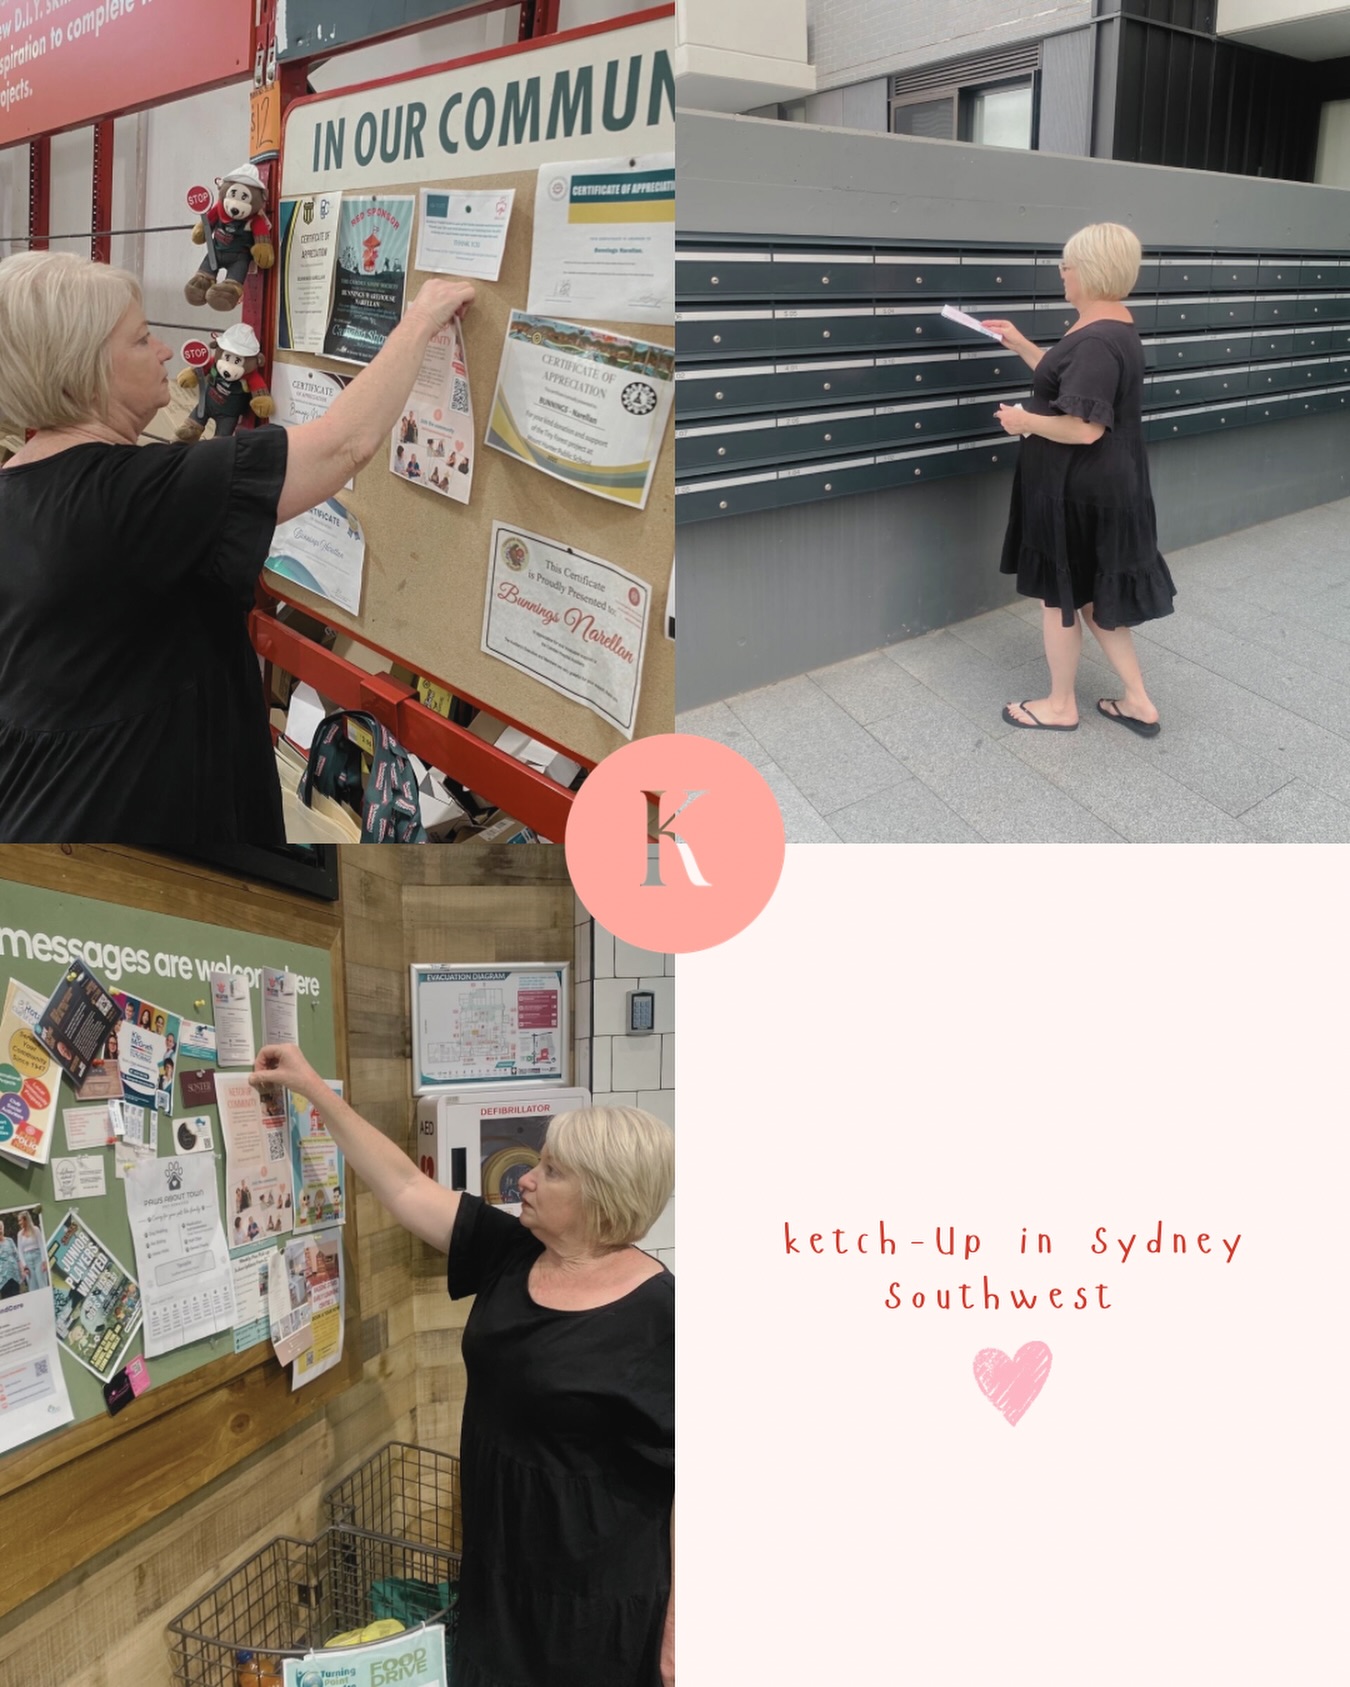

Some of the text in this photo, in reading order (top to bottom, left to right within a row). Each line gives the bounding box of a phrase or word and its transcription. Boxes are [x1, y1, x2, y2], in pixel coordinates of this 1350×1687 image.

[50, 26, 63, 50] to
[66, 0, 135, 41] complete
[313, 49, 675, 172] IN OUR COMMUN
[188, 192, 209, 206] STOP
[572, 184, 620, 196] CERTIFICATE
[621, 183, 631, 195] OF
[351, 208, 400, 230] RED SPONSOR
[184, 347, 207, 360] STOP
[541, 353, 617, 384] CERTIFICATE OF
[291, 380, 335, 397] CERTIFICATE
[542, 371, 608, 399] APPRECIATION
[539, 396, 569, 414] BUNNINGS
[545, 560, 606, 592] This Certificate
[528, 571, 535, 580] is
[536, 574, 566, 595] Proudly
[567, 588, 608, 611] Presented
[497, 581, 560, 626] Bunnings
[563, 607, 634, 665] Narellan
[0, 926, 151, 981] messages
[154, 951, 193, 981] are
[426, 972, 506, 982] EVACUATION DIAGRAM
[480, 1104, 551, 1117] DEFIBRILLATOR
[419, 1120, 435, 1136] AED
[144, 1196, 163, 1206] PAWS
[164, 1192, 185, 1203] ABOUT
[61, 1231, 90, 1273] JUNIOR
[64, 1241, 99, 1290] PLAYERS
[76, 1252, 108, 1298] WANTED
[320, 1667, 357, 1679] Turning
[370, 1647, 427, 1676] FOOD
[370, 1660, 429, 1687] DRIVE
[324, 1676, 350, 1687] Point
